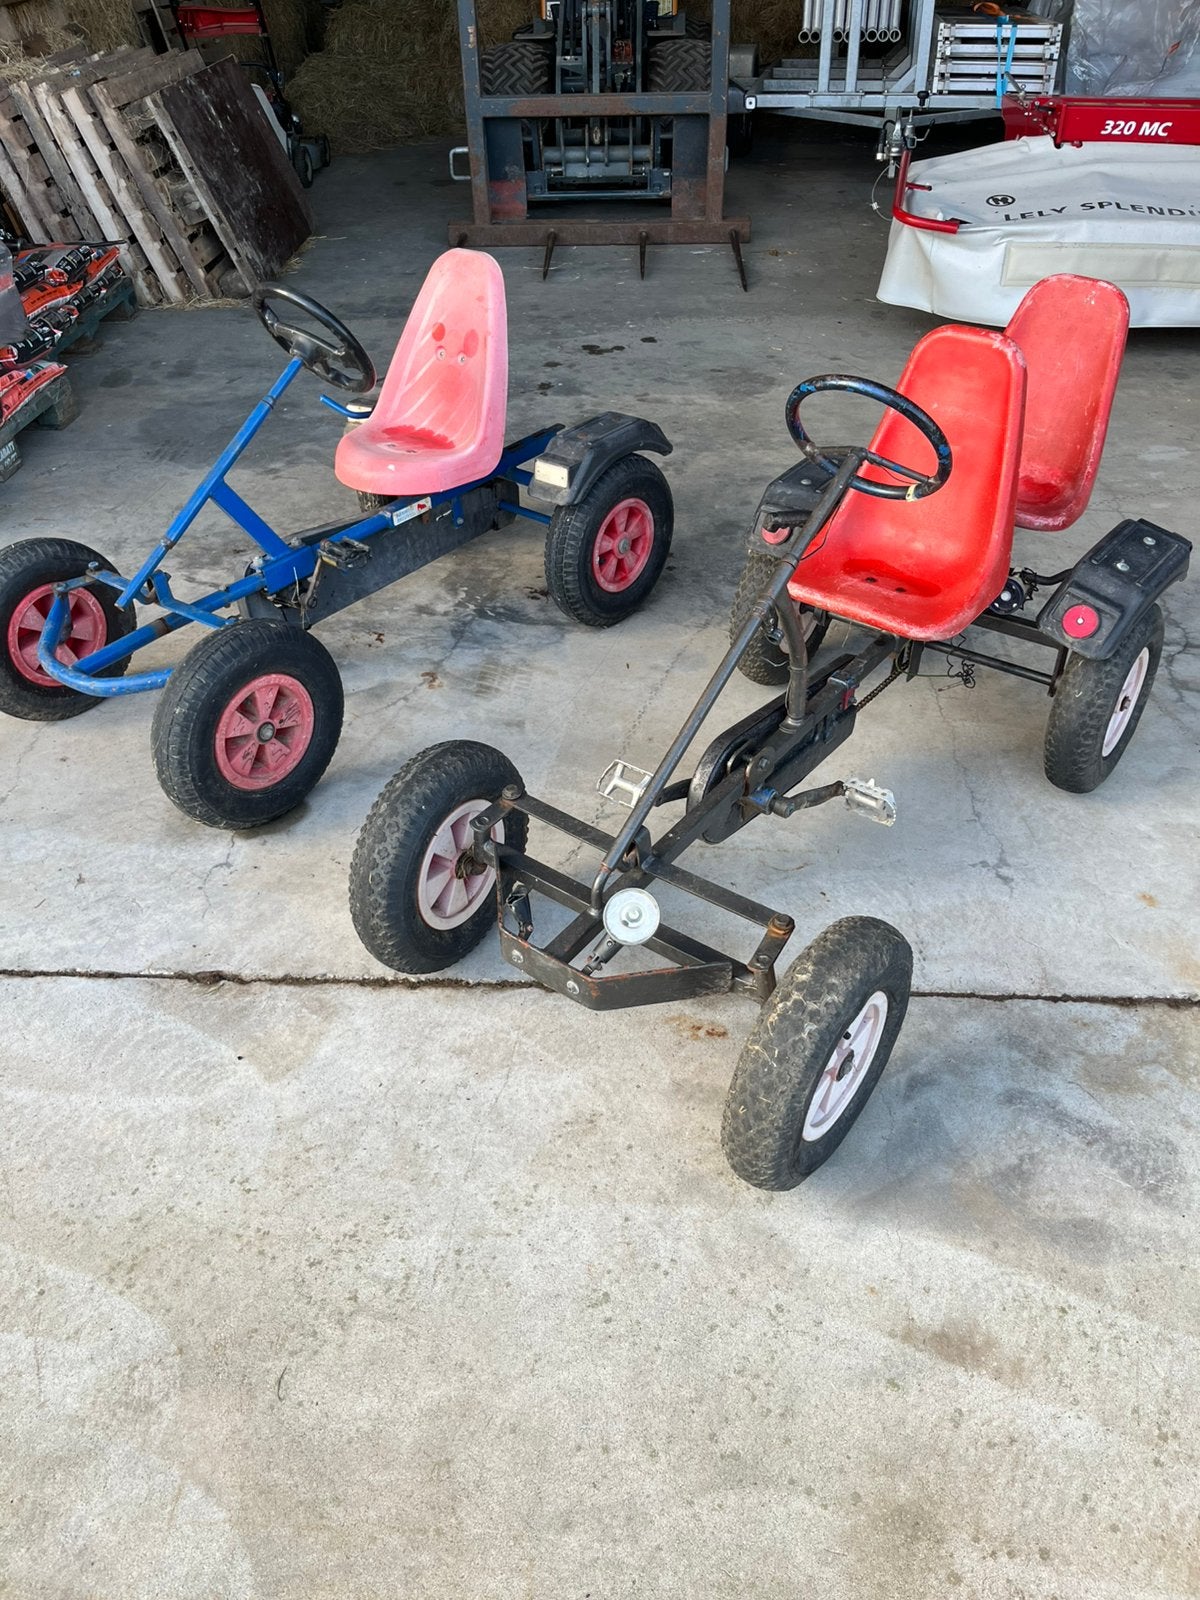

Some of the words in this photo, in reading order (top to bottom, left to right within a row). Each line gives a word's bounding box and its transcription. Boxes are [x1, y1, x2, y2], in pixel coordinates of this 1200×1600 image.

[1100, 119, 1137, 136] 320
[1138, 121, 1173, 137] MC
[1004, 205, 1068, 222] LELY
[1080, 201, 1200, 216] SPLENDI
